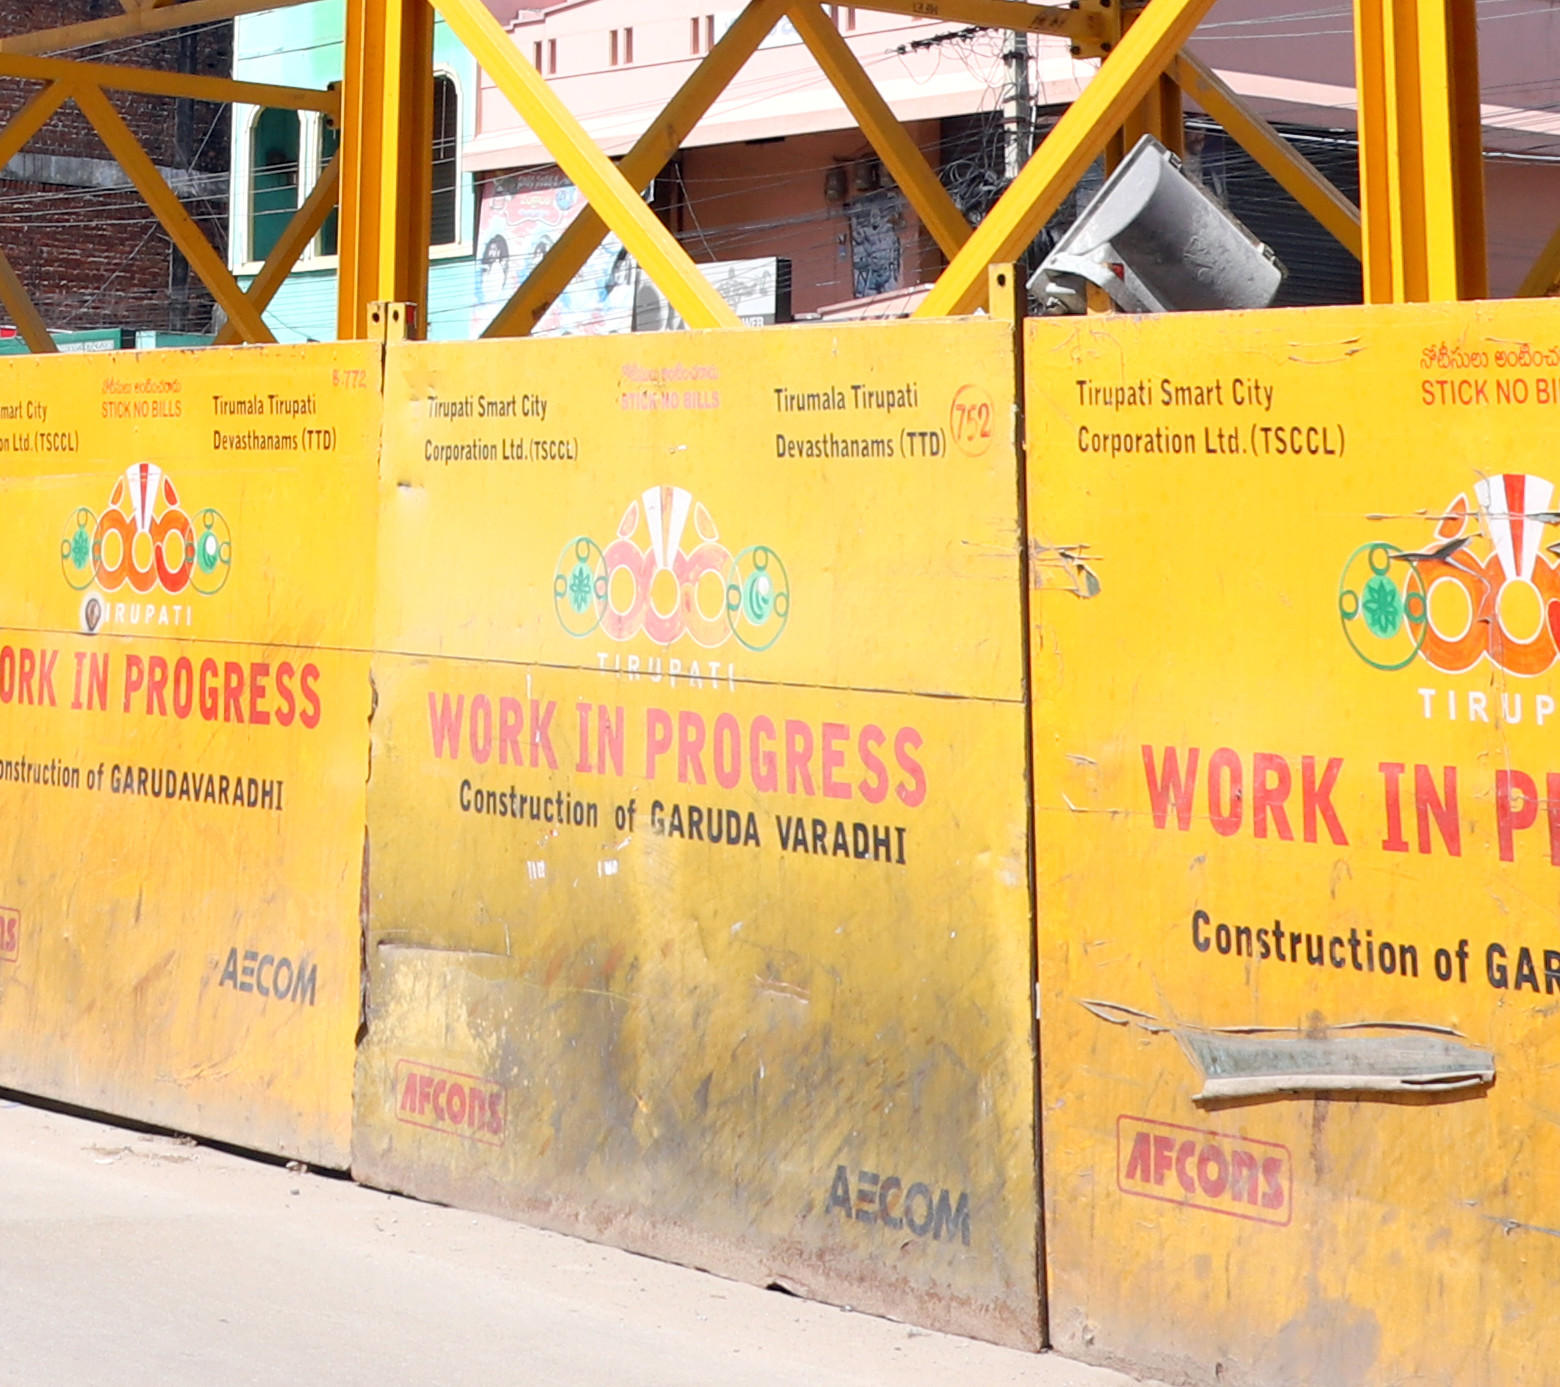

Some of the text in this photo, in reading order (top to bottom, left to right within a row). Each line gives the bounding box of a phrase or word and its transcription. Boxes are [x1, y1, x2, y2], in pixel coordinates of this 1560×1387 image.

[212, 394, 317, 419] Tirumala Tirupati
[427, 393, 547, 422] Tirupati Smart City
[774, 382, 919, 414] Tirumala Tirupati
[1076, 378, 1274, 412] Tirupati Smart City
[1421, 380, 1489, 406] STICK
[1496, 378, 1529, 404] NO
[26, 400, 48, 421] City
[101, 400, 182, 419] STICK NO BILLS
[953, 401, 993, 443] 752
[213, 427, 337, 452] Devasthanams (TTD)
[424, 439, 498, 467] Corporation
[776, 427, 947, 461] Devasthanams (TTD)
[1078, 424, 1197, 458] Corporation
[86, 599, 193, 627] IRUPATI
[596, 652, 738, 693] TIRUPATI
[70, 651, 109, 711] IN
[123, 653, 322, 729] PROGRESS
[428, 691, 928, 808] WORK IN PROGRESS
[86, 762, 104, 791] of
[110, 763, 284, 811] GARUDAVARADHI
[1141, 744, 1350, 847] WORK
[1378, 761, 1461, 858] IN
[460, 779, 908, 865] Construction of GARUDA VARADHI
[1191, 909, 1418, 979] Construction
[1433, 938, 1470, 984] of
[220, 944, 317, 1007] AECOM
[824, 1165, 970, 1247] AECOM
